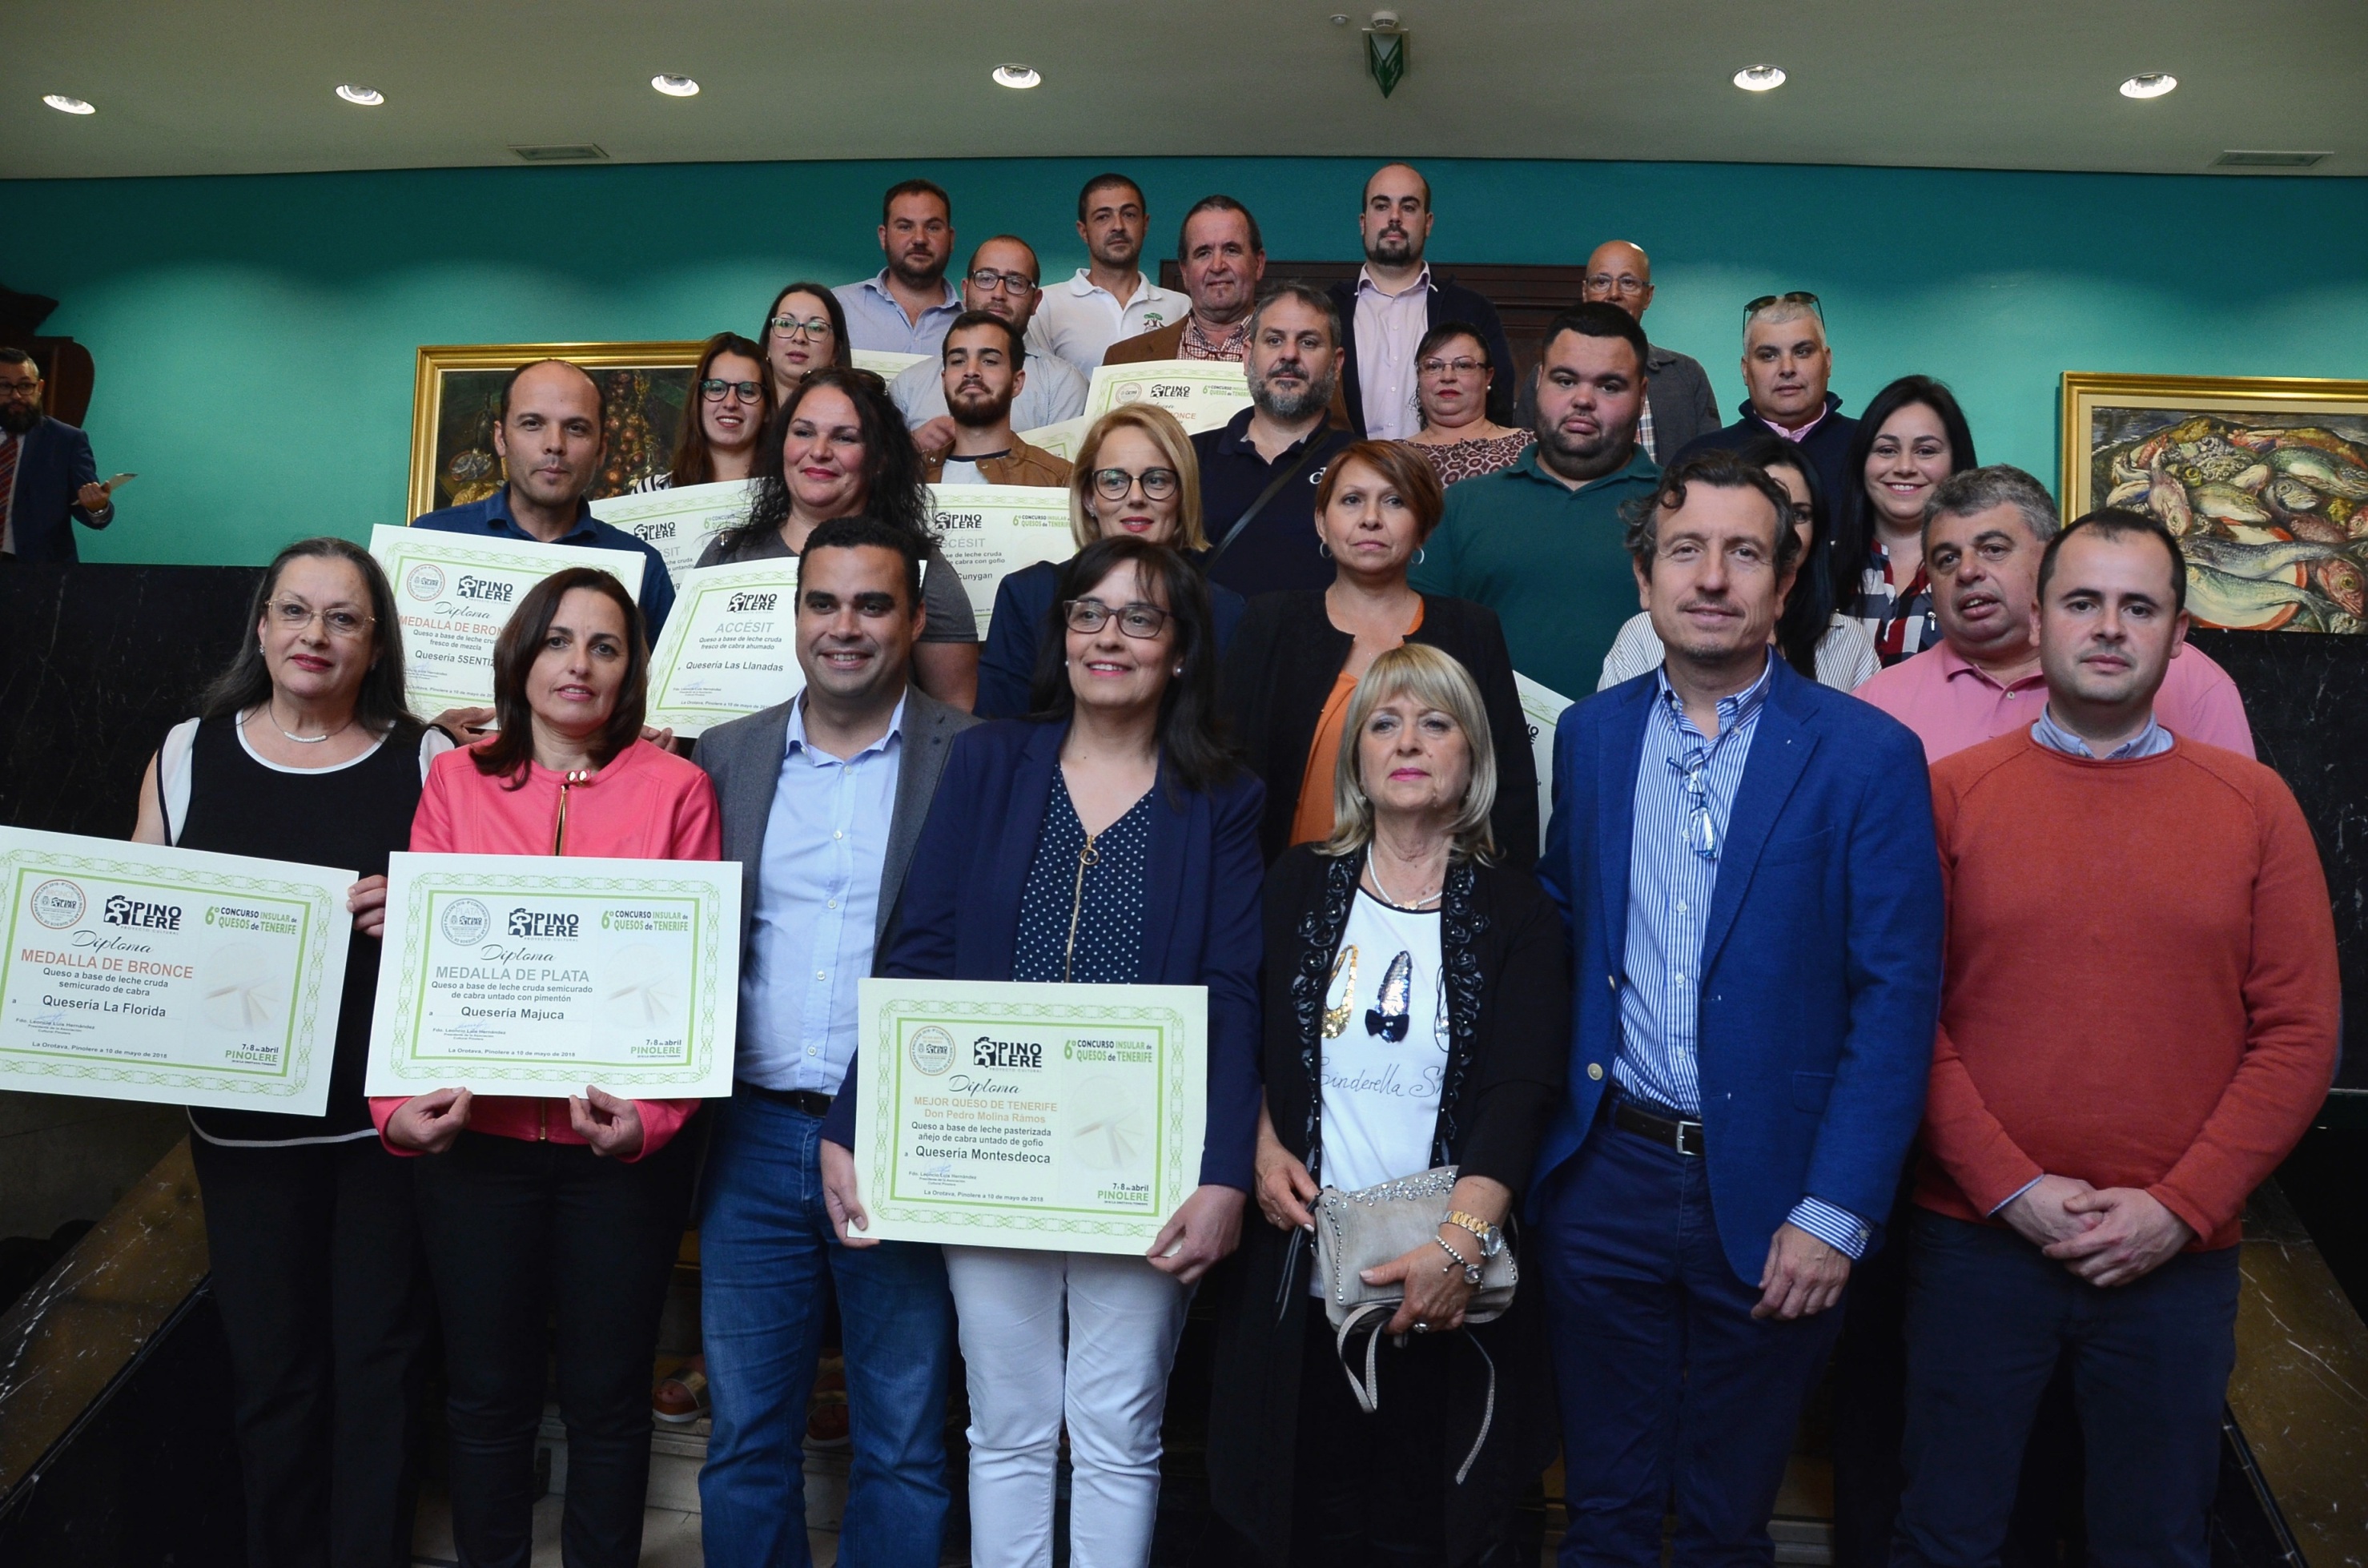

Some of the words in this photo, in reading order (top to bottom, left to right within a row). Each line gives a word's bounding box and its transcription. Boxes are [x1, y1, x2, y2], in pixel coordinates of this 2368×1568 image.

[649, 522, 675, 531] PINO
[649, 529, 676, 540] LERE
[480, 581, 513, 592] PINO
[476, 590, 512, 601] LERE
[746, 593, 777, 601] PINO
[434, 601, 491, 619] Diploma
[744, 601, 775, 610] LERE
[400, 615, 451, 630] MEDALLA
[455, 622, 469, 632] DE
[473, 624, 501, 637] BRON
[716, 621, 774, 633] ACCÉSIT
[430, 639, 449, 647] fresco
[725, 661, 740, 669] Las
[743, 661, 783, 672] Llanadas
[133, 902, 182, 919] PINO
[221, 907, 259, 918] CONCURSO
[260, 912, 290, 922] INSULAR
[615, 911, 651, 919] CONCURSO
[131, 914, 180, 931] LERE
[535, 913, 579, 925] PINO
[219, 917, 250, 928] QUESOS
[261, 922, 296, 935] TENERIFE
[533, 925, 578, 937] LERE
[614, 920, 644, 931] QUESOS
[653, 921, 688, 931] TENERIFE
[71, 930, 154, 953] Diploma
[480, 944, 556, 965] Diploma
[21, 949, 97, 968] MEDALLA
[103, 958, 123, 971] DE
[128, 961, 194, 979] BRONCE
[43, 967, 72, 977] Queso
[82, 972, 103, 981] base
[119, 975, 141, 984] leche
[144, 979, 168, 987] cruda
[436, 967, 510, 980] MEDALLA
[516, 969, 536, 980] DE
[541, 970, 589, 982] PLATA
[59, 981, 111, 993] semicurado
[113, 985, 123, 993] de
[126, 987, 150, 995] cabra
[432, 981, 457, 990] Queso
[547, 985, 593, 993] semicurado
[534, 995, 571, 1003] pimentón
[42, 995, 99, 1011] Quesería
[104, 1001, 118, 1012] La
[123, 1003, 166, 1017] Florida
[461, 1007, 517, 1018] Quesería
[521, 1008, 564, 1021] Majuca
[999, 1043, 1042, 1055] PINO
[1077, 1040, 1114, 1048] CONCURSO
[1116, 1041, 1144, 1049] INSULAR
[225, 1050, 278, 1062] PINOLERE
[998, 1055, 1042, 1067] LERE
[1077, 1050, 1106, 1062] QUESOS
[1117, 1051, 1152, 1063] TENERIFE
[949, 1075, 1021, 1097] Diploma
[915, 1097, 948, 1106] MEJOR
[952, 1099, 987, 1108] QUESO
[991, 1100, 1005, 1109] DE
[1008, 1101, 1057, 1112] TENERIFE
[925, 1109, 943, 1118] Don
[947, 1111, 974, 1120] Pedro
[978, 1112, 1009, 1121] Molina
[911, 1122, 937, 1130] Queso
[947, 1124, 966, 1132] base
[1004, 1127, 1051, 1136] pasterizada
[919, 1133, 940, 1142] añejo
[979, 1136, 1007, 1144] untado
[1023, 1139, 1043, 1147] gofio
[916, 1146, 967, 1159] Quesería
[971, 1149, 1051, 1163] Montesdeoca
[1098, 1191, 1148, 1201] PINOLERE
